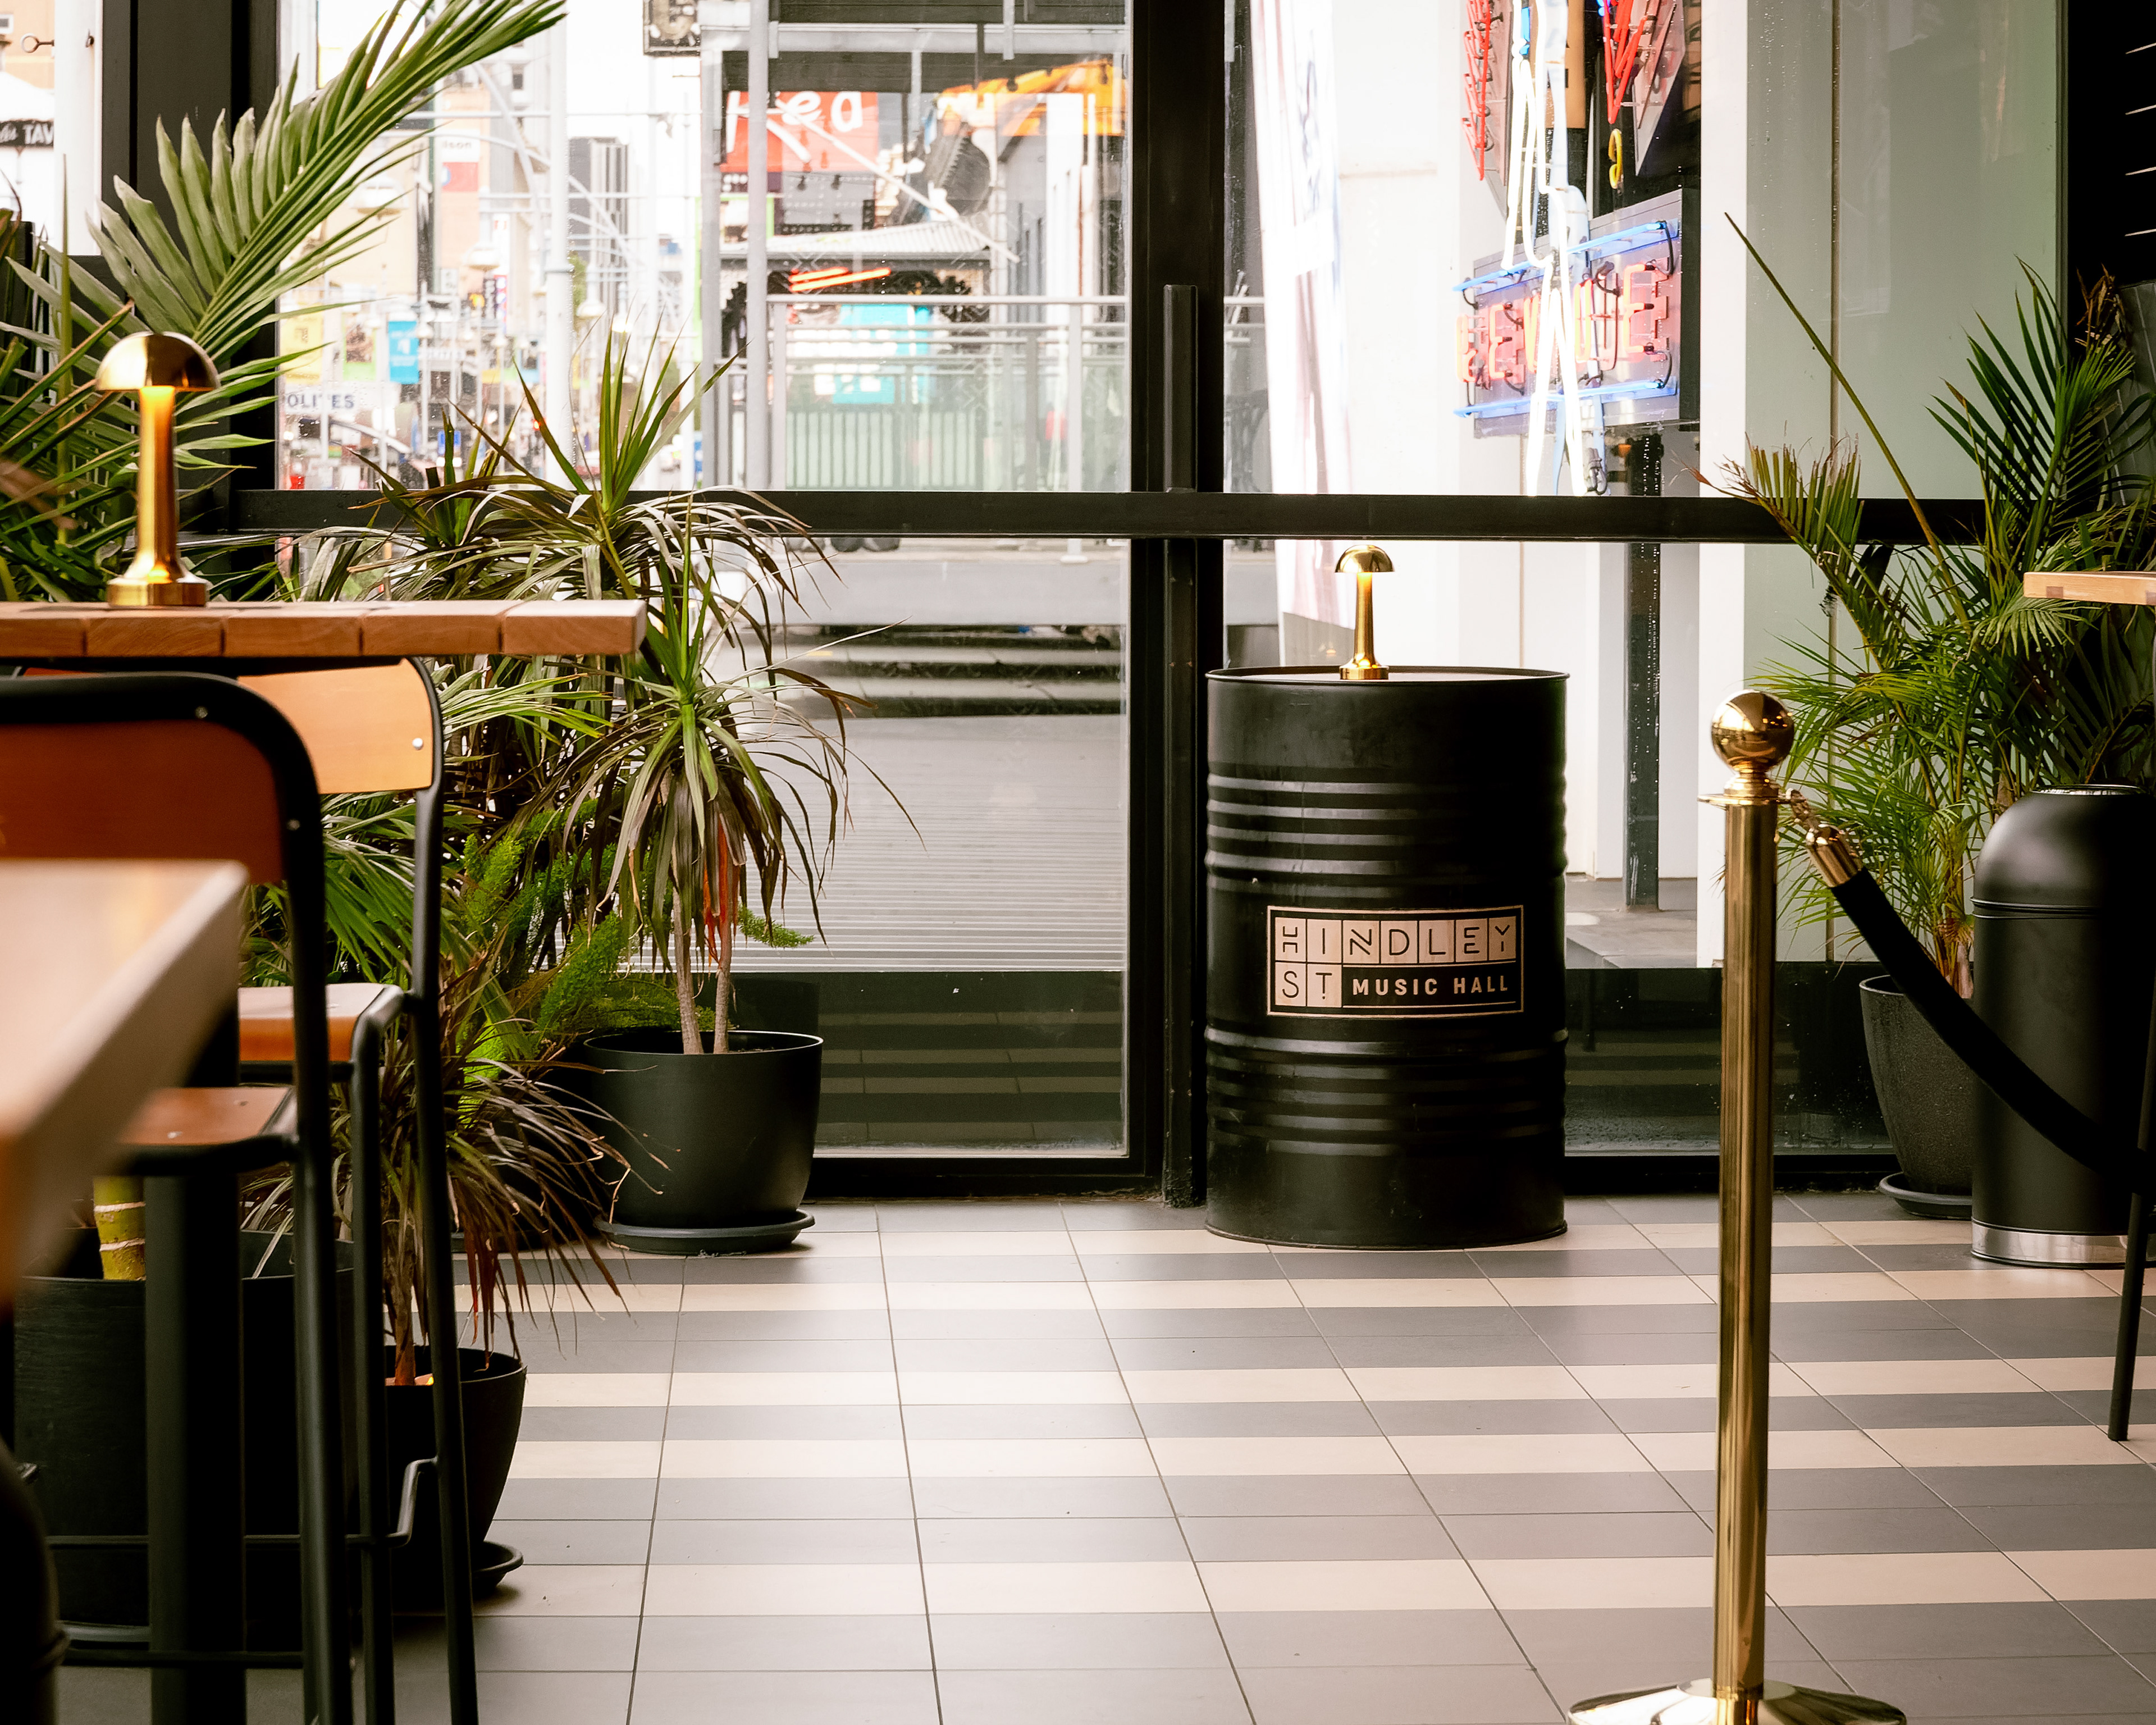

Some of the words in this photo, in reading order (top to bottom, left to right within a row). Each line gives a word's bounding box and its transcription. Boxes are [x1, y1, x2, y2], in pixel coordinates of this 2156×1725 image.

[1282, 924, 1511, 956] HINDLEY
[1352, 978, 1438, 996] MUSIC
[1453, 975, 1509, 994] HALL
